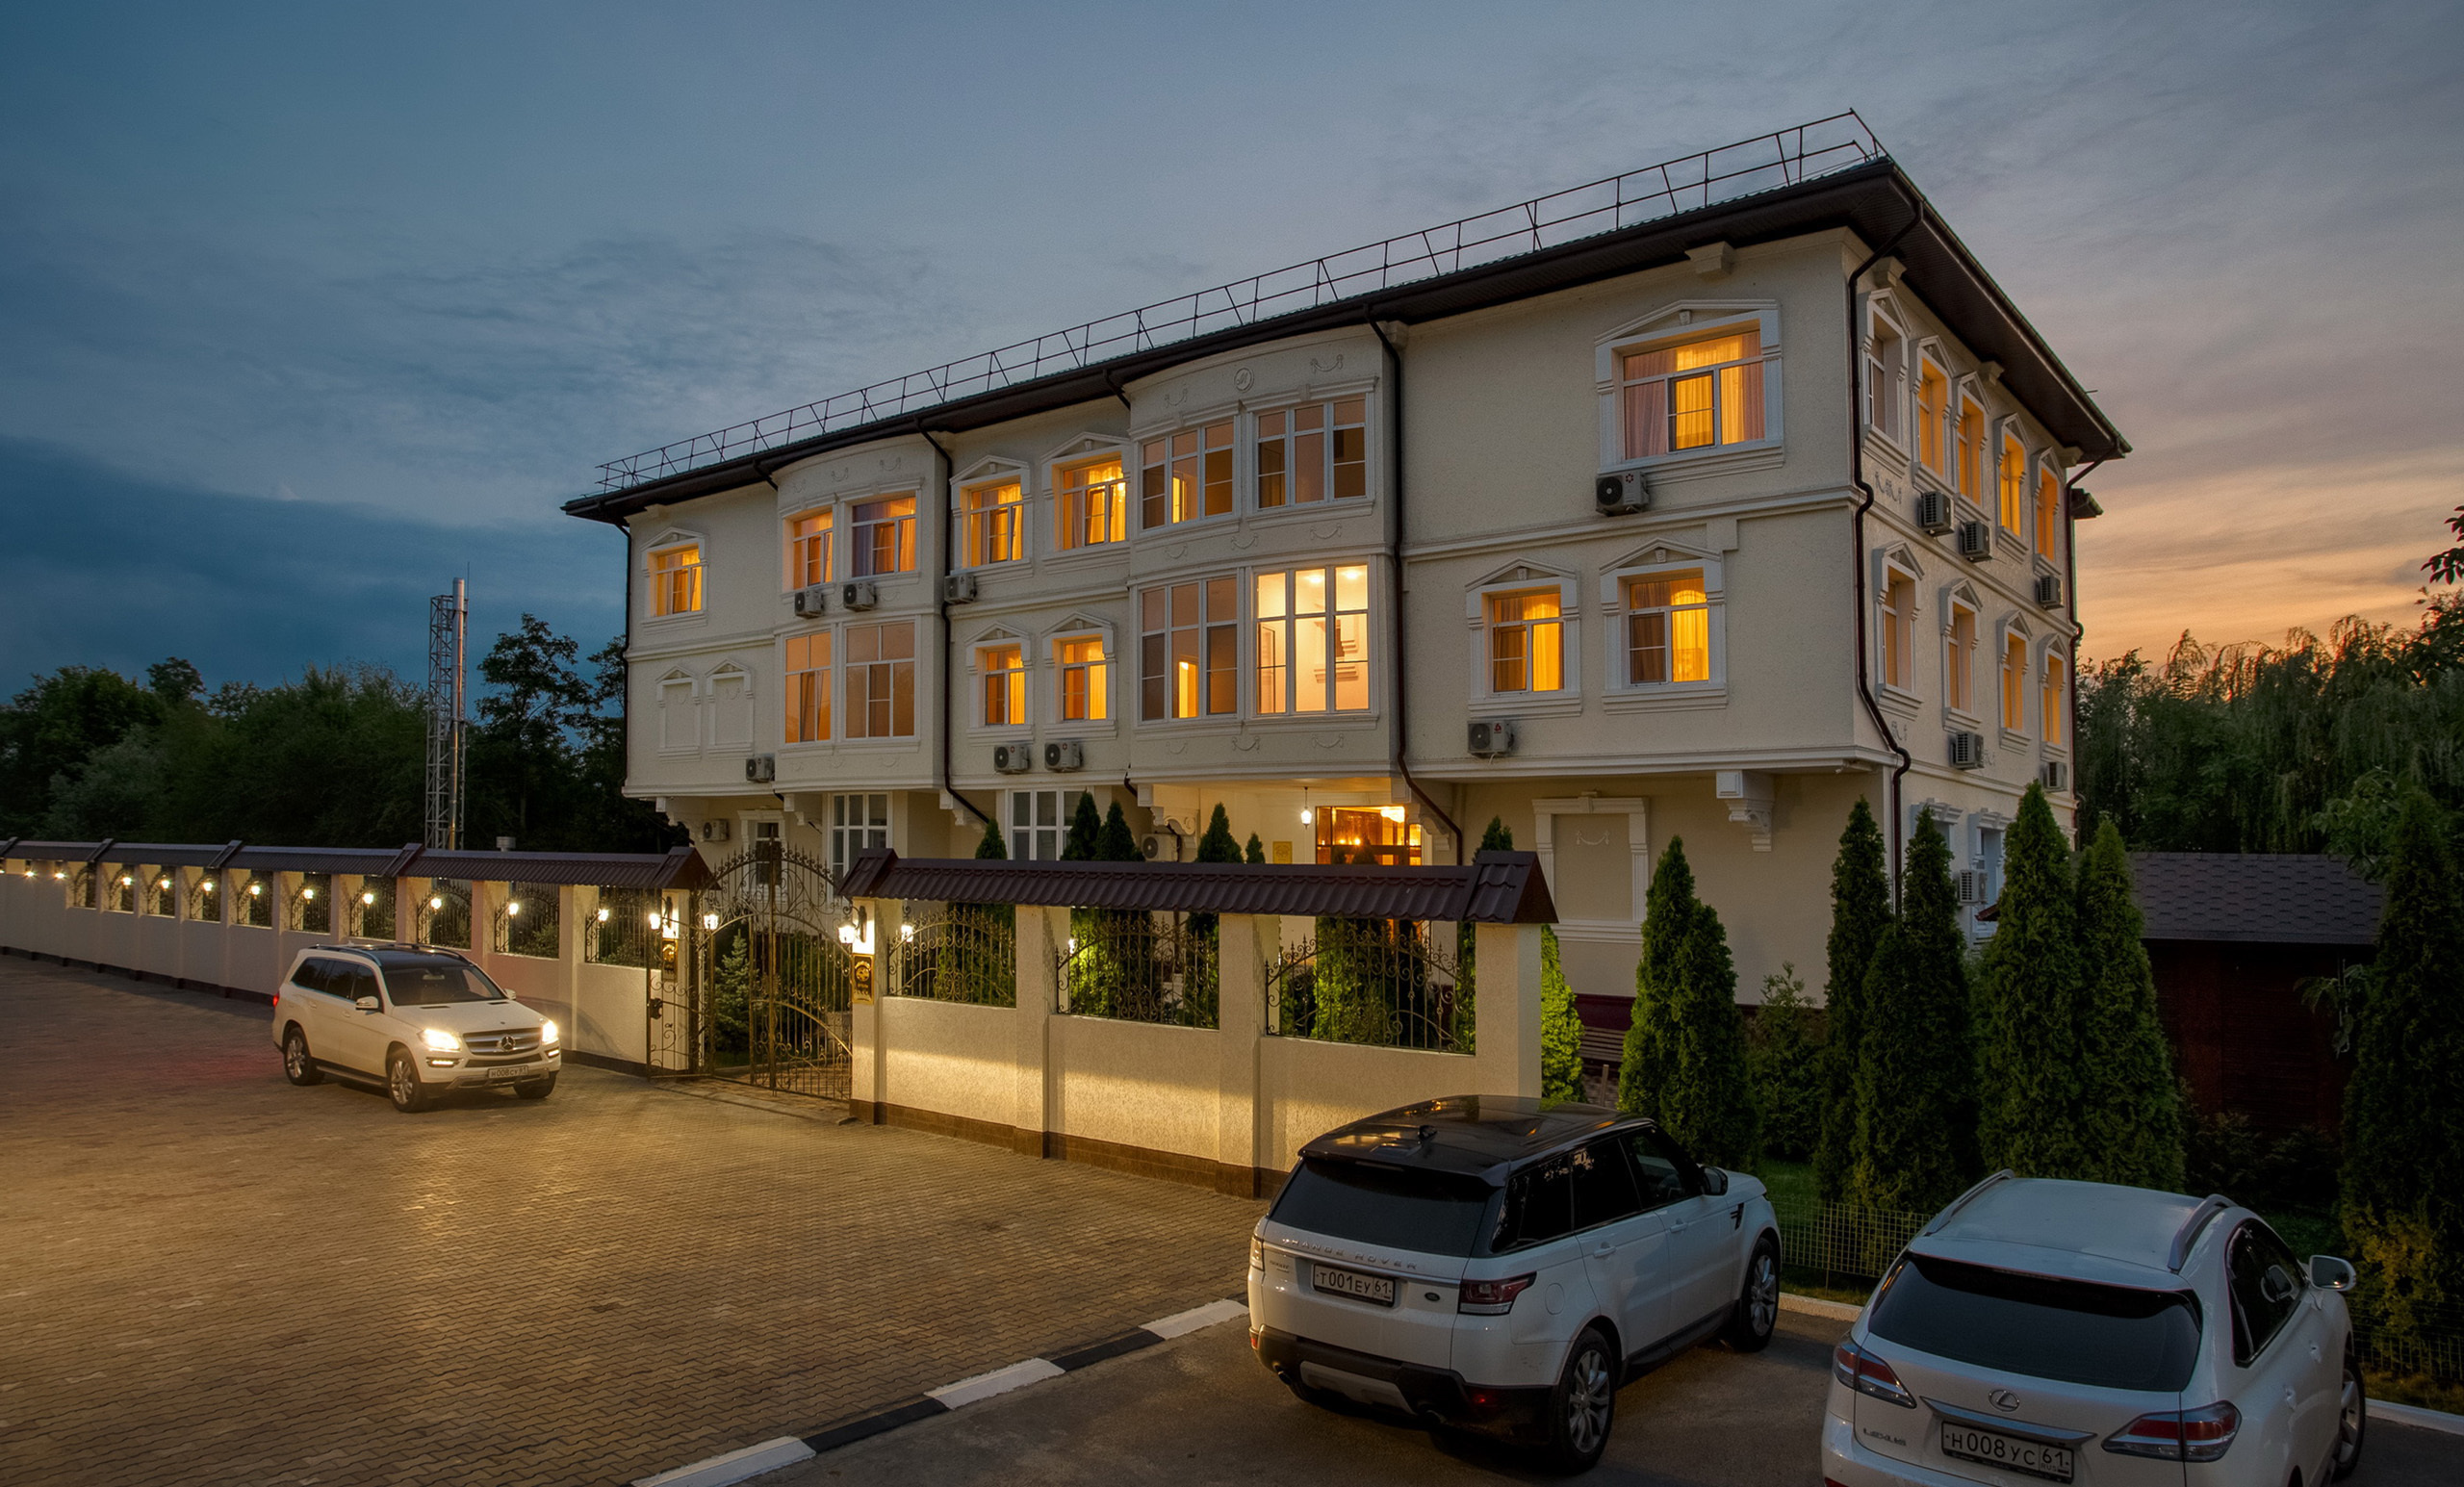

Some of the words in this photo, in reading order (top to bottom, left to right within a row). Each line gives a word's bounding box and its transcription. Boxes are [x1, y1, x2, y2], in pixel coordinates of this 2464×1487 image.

[1354, 1252, 1418, 1270] ROVER
[1374, 1280, 1388, 1295] 61
[2041, 1448, 2064, 1467] 61
